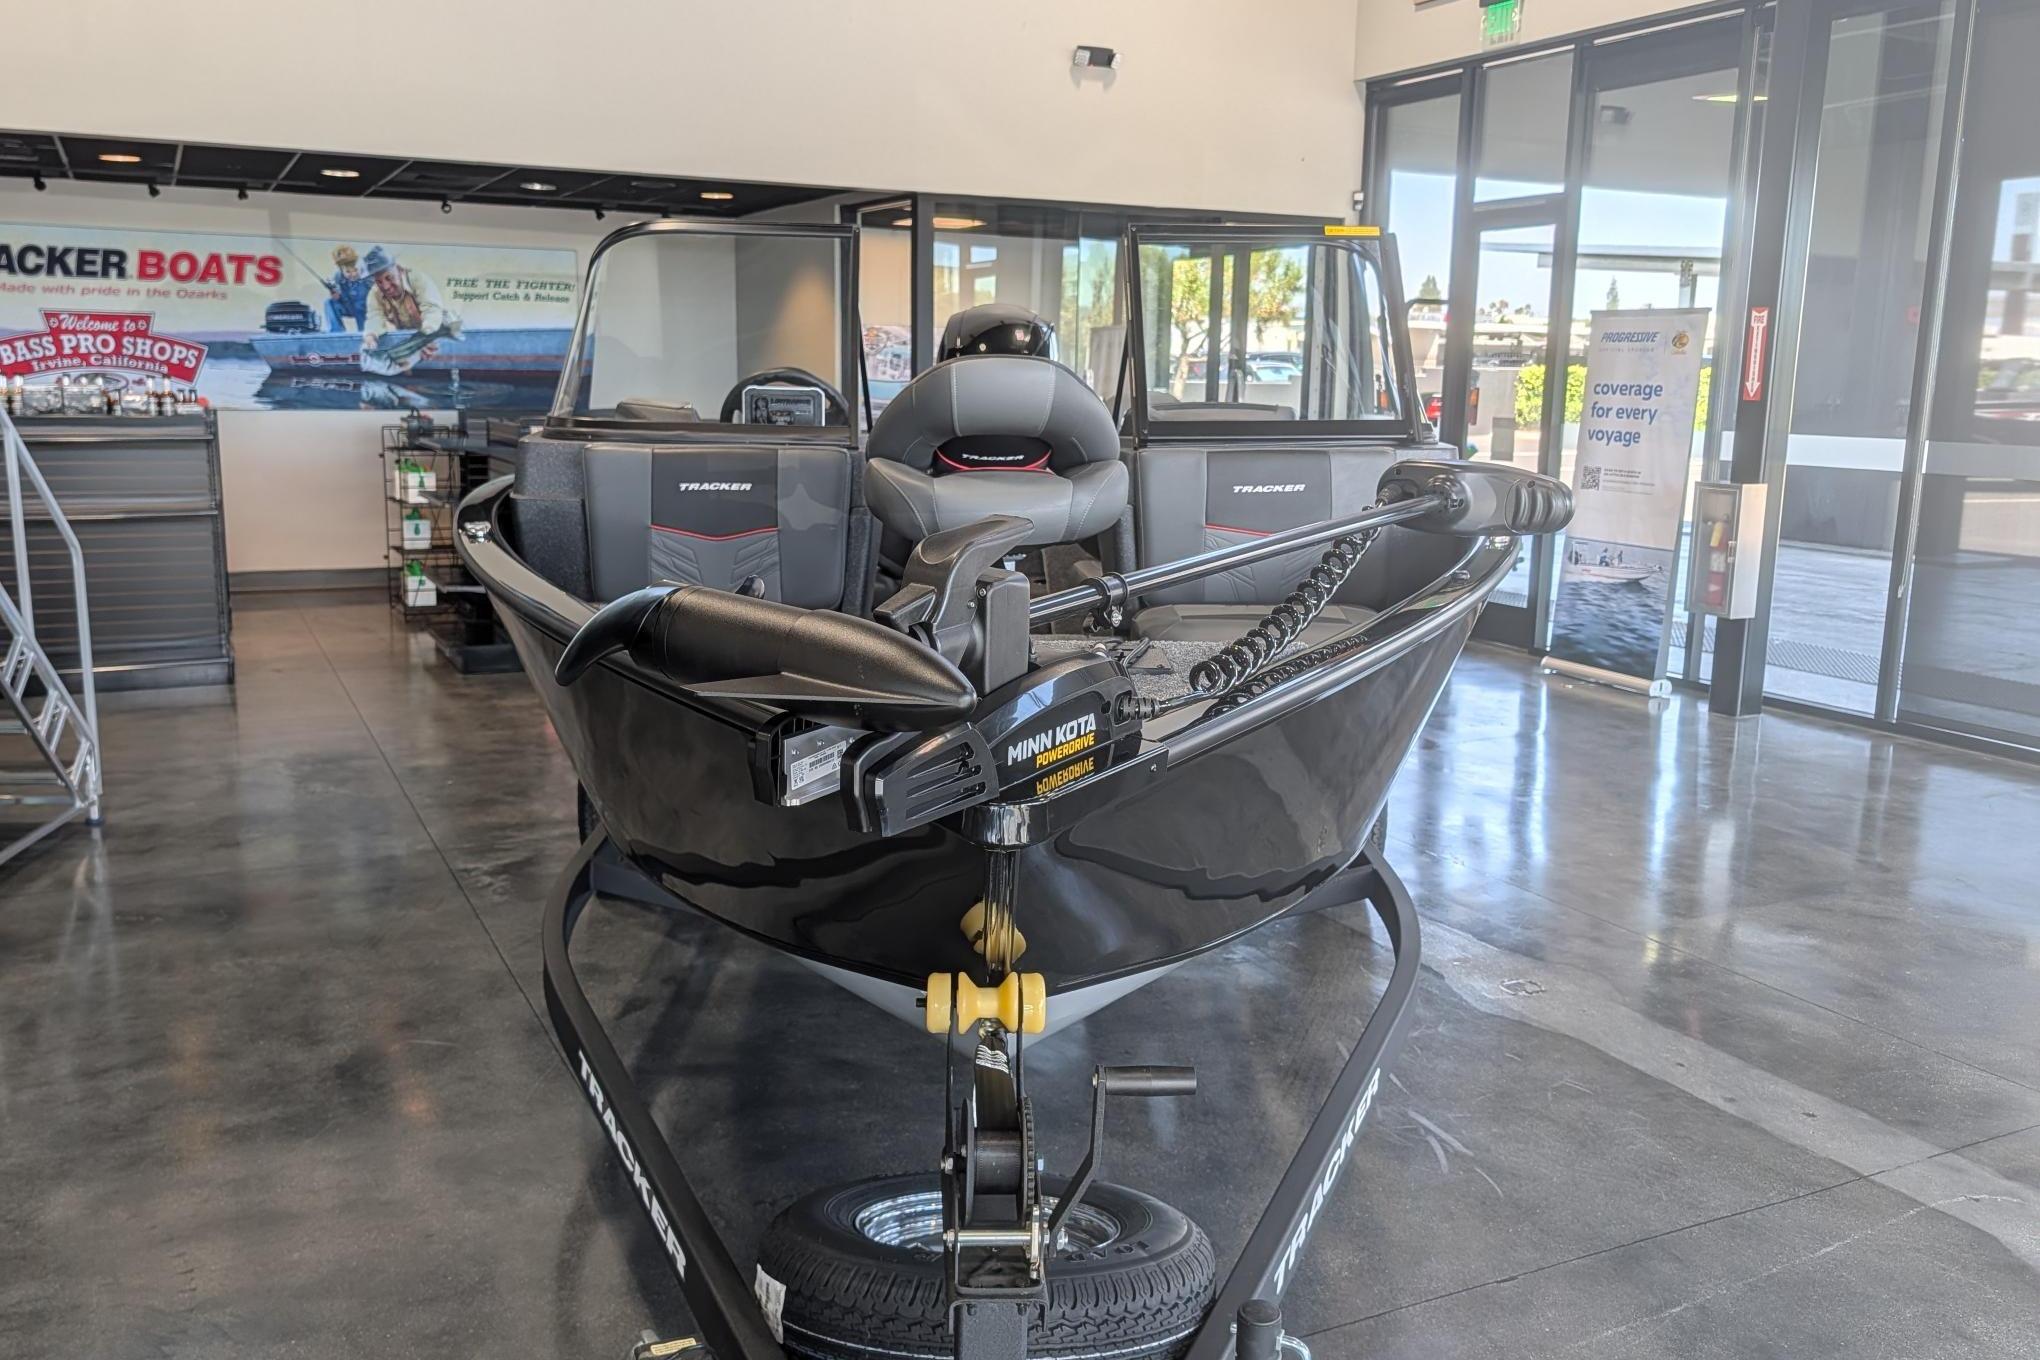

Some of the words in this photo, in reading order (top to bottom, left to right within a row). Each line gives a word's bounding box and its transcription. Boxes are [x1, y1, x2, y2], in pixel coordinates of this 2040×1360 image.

[137, 249, 283, 286] BOATS
[446, 277, 479, 288] FREE
[486, 279, 510, 289] THE
[42, 284, 75, 295] with
[80, 286, 121, 299] pride
[127, 287, 141, 297] in
[146, 288, 170, 299] the
[176, 289, 228, 301] Ozarks
[452, 291, 489, 301] Support
[492, 292, 520, 301] Catch
[534, 293, 570, 303] Release
[59, 314, 119, 331] Welcome
[123, 318, 137, 332] to
[1600, 331, 1660, 343] PROGRESSIVE
[0, 334, 57, 365] BASS
[60, 333, 116, 354] PRO
[122, 336, 198, 369] SHOPS
[32, 357, 87, 372] Irvine,
[90, 355, 169, 373] California
[1593, 383, 1663, 401] coverage
[1591, 401, 1613, 418] for
[1615, 406, 1658, 425] every
[1588, 428, 1641, 447] voyage
[680, 482, 752, 491] TRACKER
[1233, 484, 1306, 493] TRACKER
[1007, 729, 1053, 766] MINN
[1055, 713, 1097, 745] KOTA
[1036, 733, 1095, 768] POWERDRIVE
[578, 1049, 687, 1282] TRACKER
[1274, 1067, 1381, 1295] TRACKER
